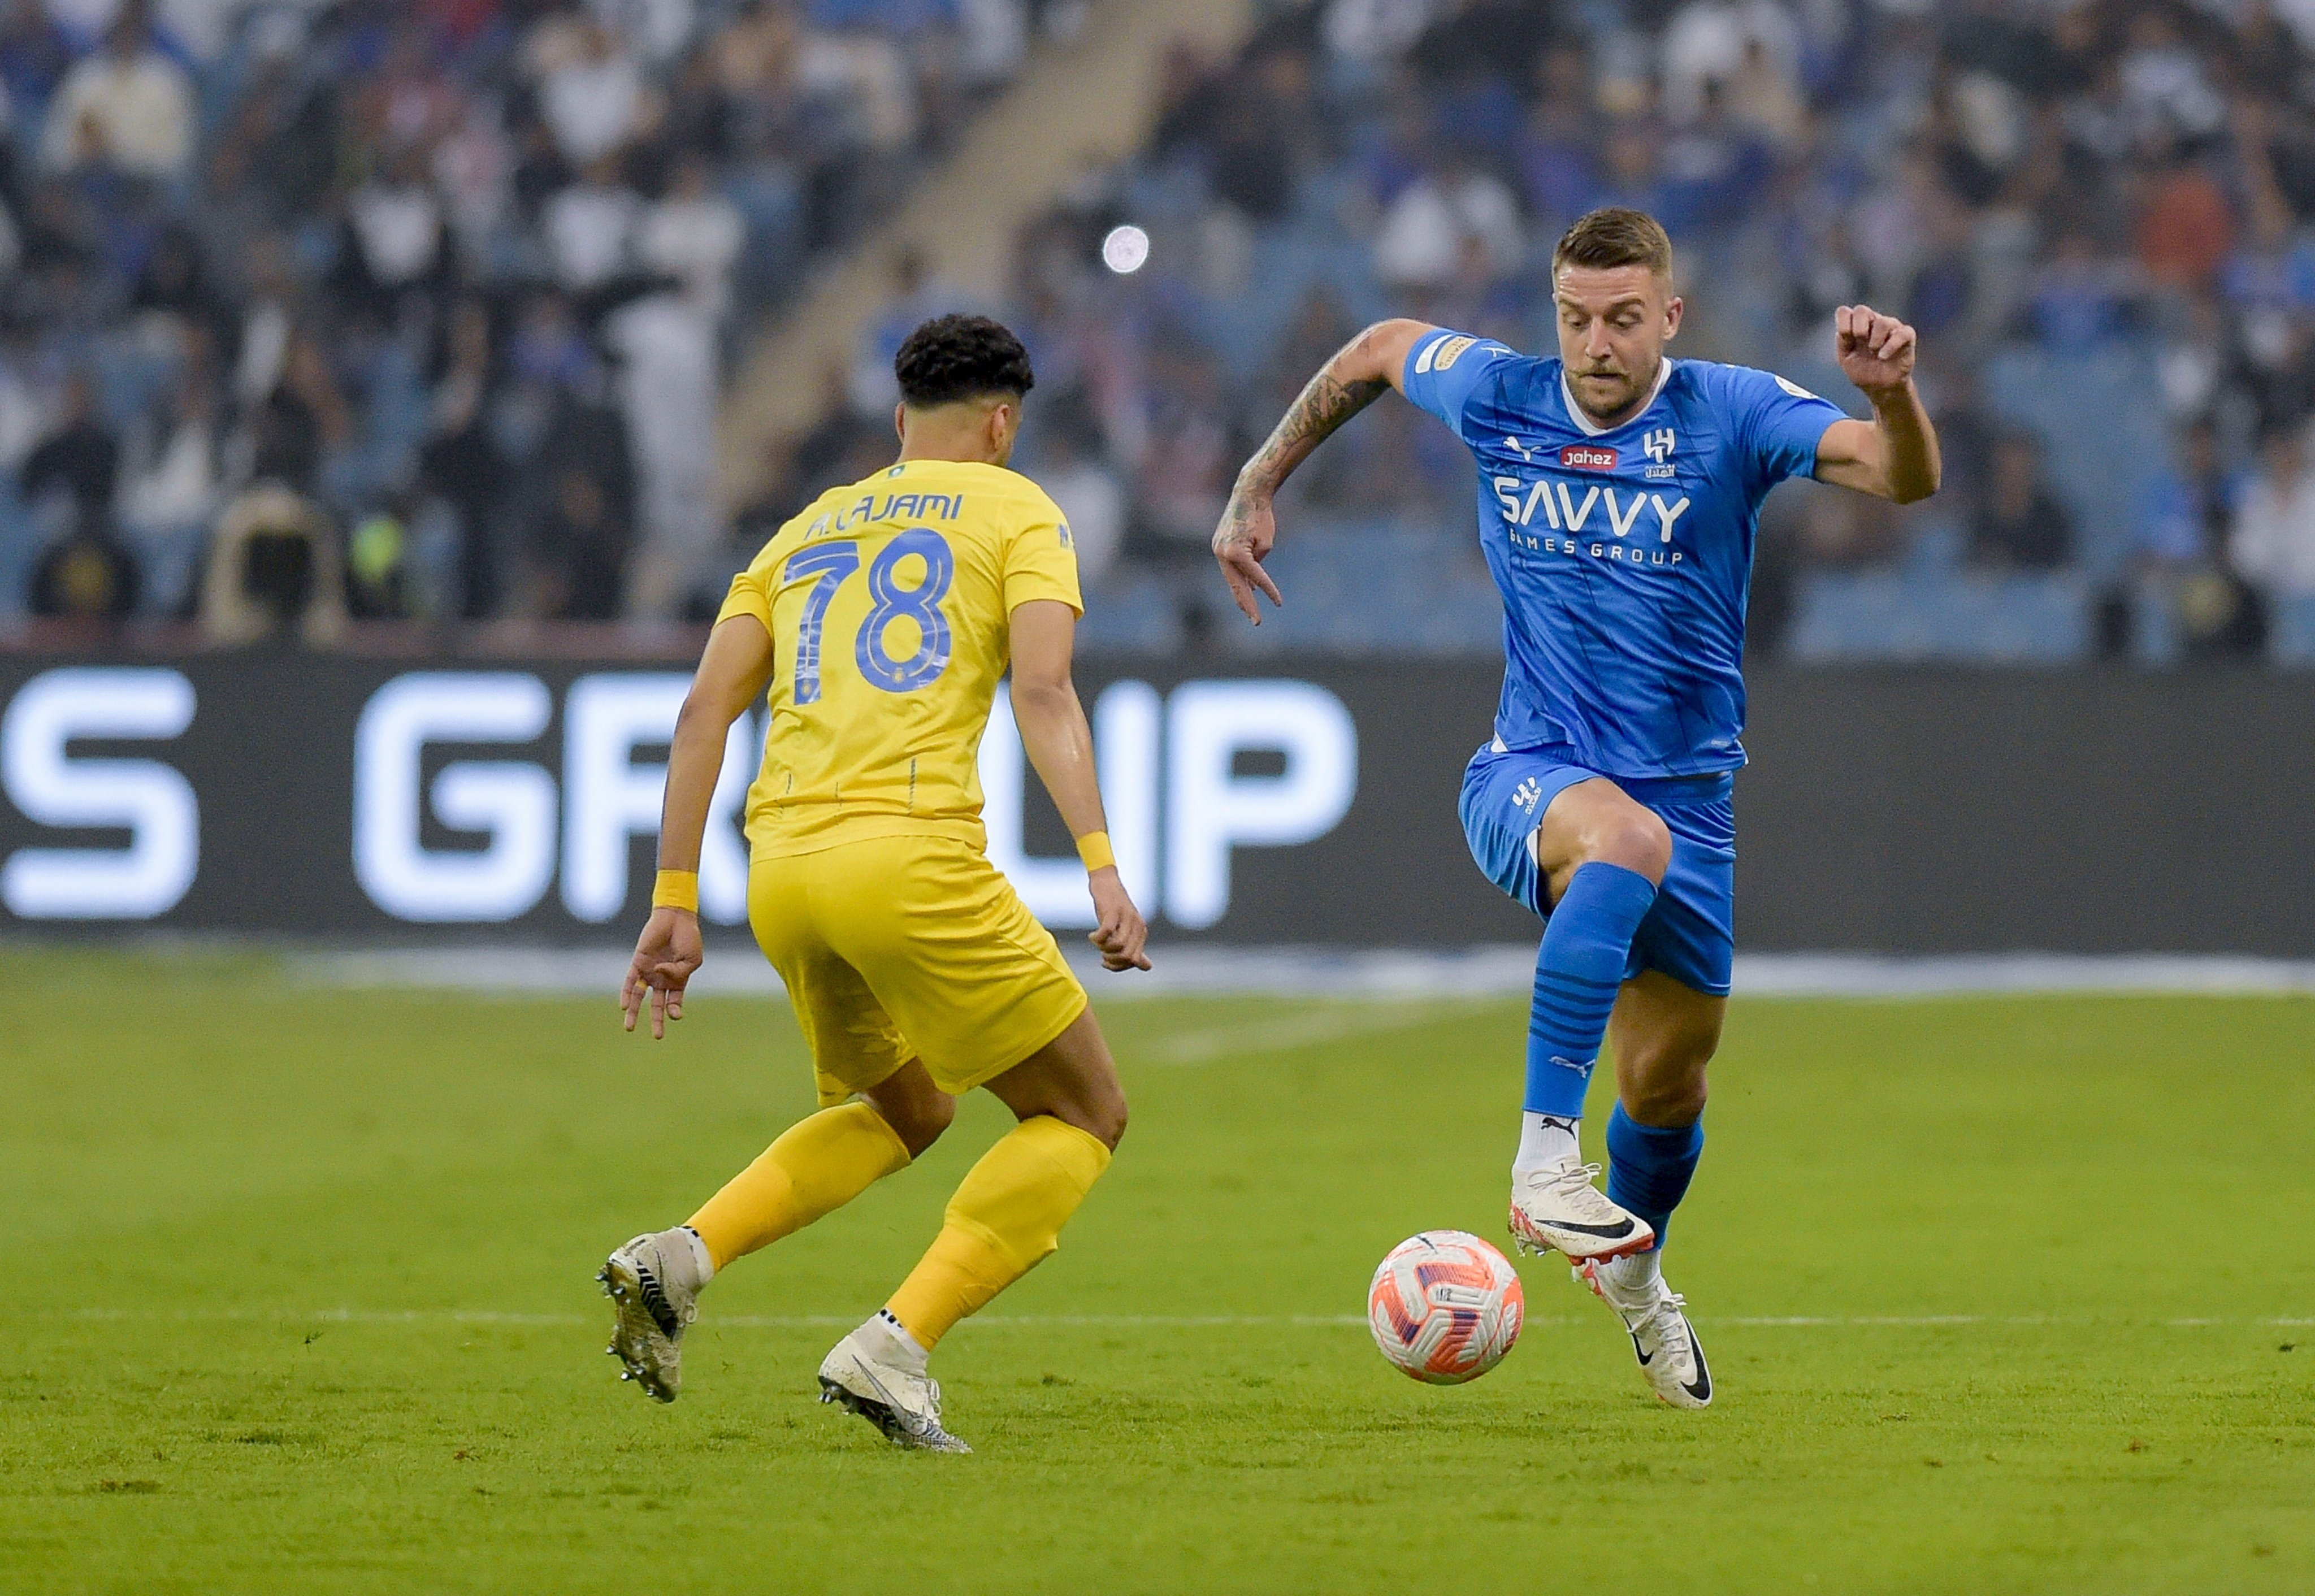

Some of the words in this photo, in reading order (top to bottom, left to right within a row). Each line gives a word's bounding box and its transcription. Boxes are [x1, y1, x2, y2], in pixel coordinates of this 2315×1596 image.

[1564, 449, 1612, 466] jahez
[1494, 476, 1690, 543] SAVVY
[1510, 527, 1575, 554] GAMES
[1590, 543, 1683, 566] GROUP
[783, 527, 954, 706] 78
[353, 669, 1358, 930] GRUP
